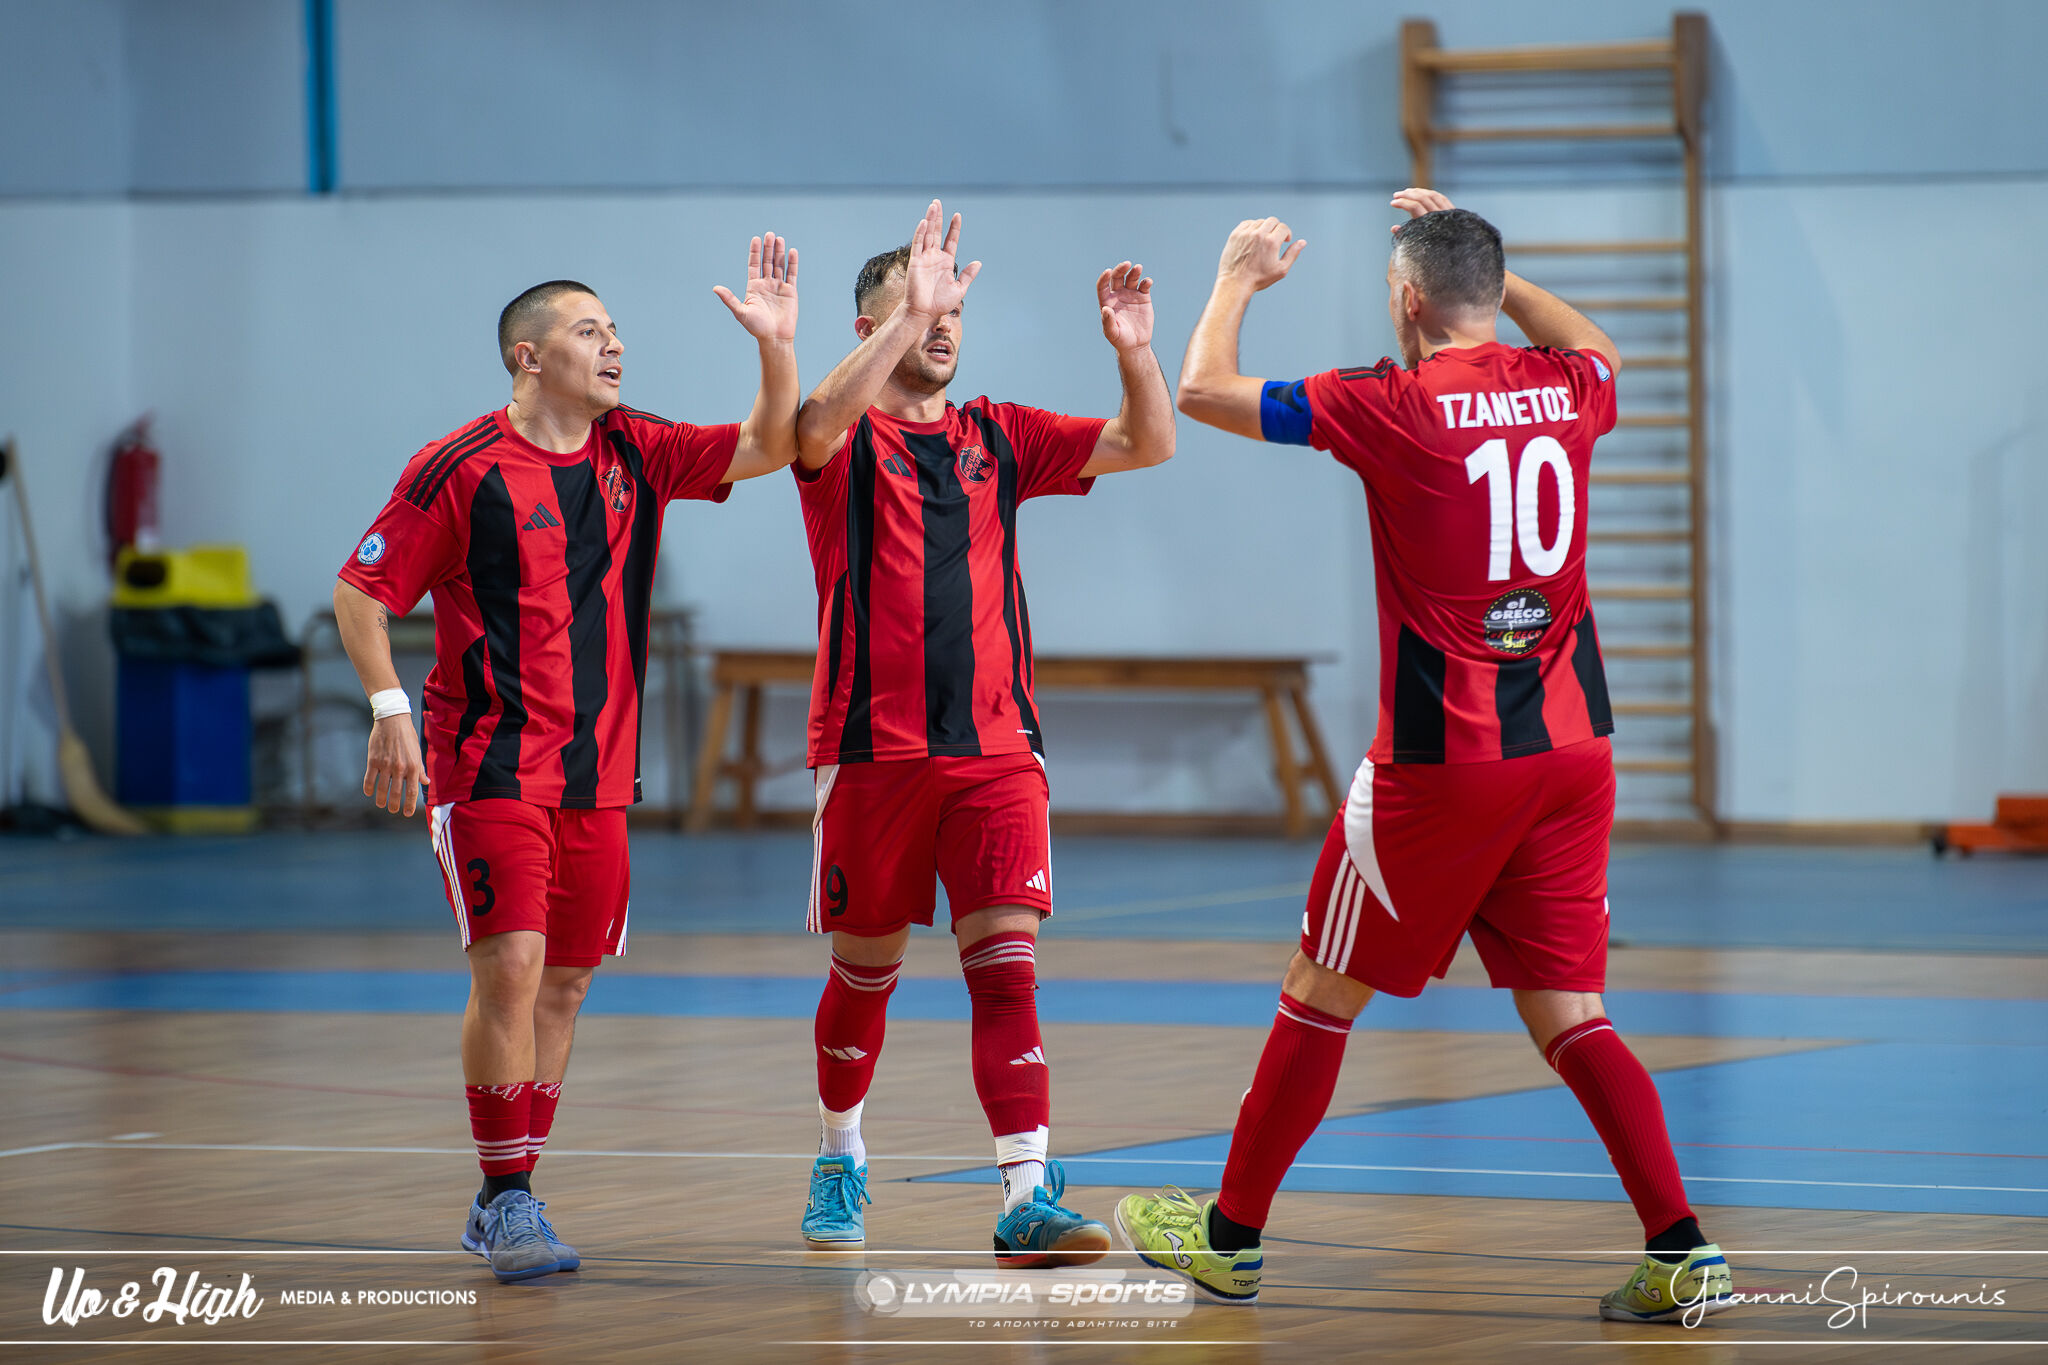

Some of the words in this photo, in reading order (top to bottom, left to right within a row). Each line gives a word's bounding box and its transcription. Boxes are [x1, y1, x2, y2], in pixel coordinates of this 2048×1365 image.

[1436, 386, 1579, 429] ΤΖΑΝΕΤΟΣ
[1464, 435, 1575, 581] 10
[1490, 608, 1546, 620] GRECO
[1506, 597, 1527, 609] el
[467, 857, 495, 916] 3
[826, 864, 848, 916] 9
